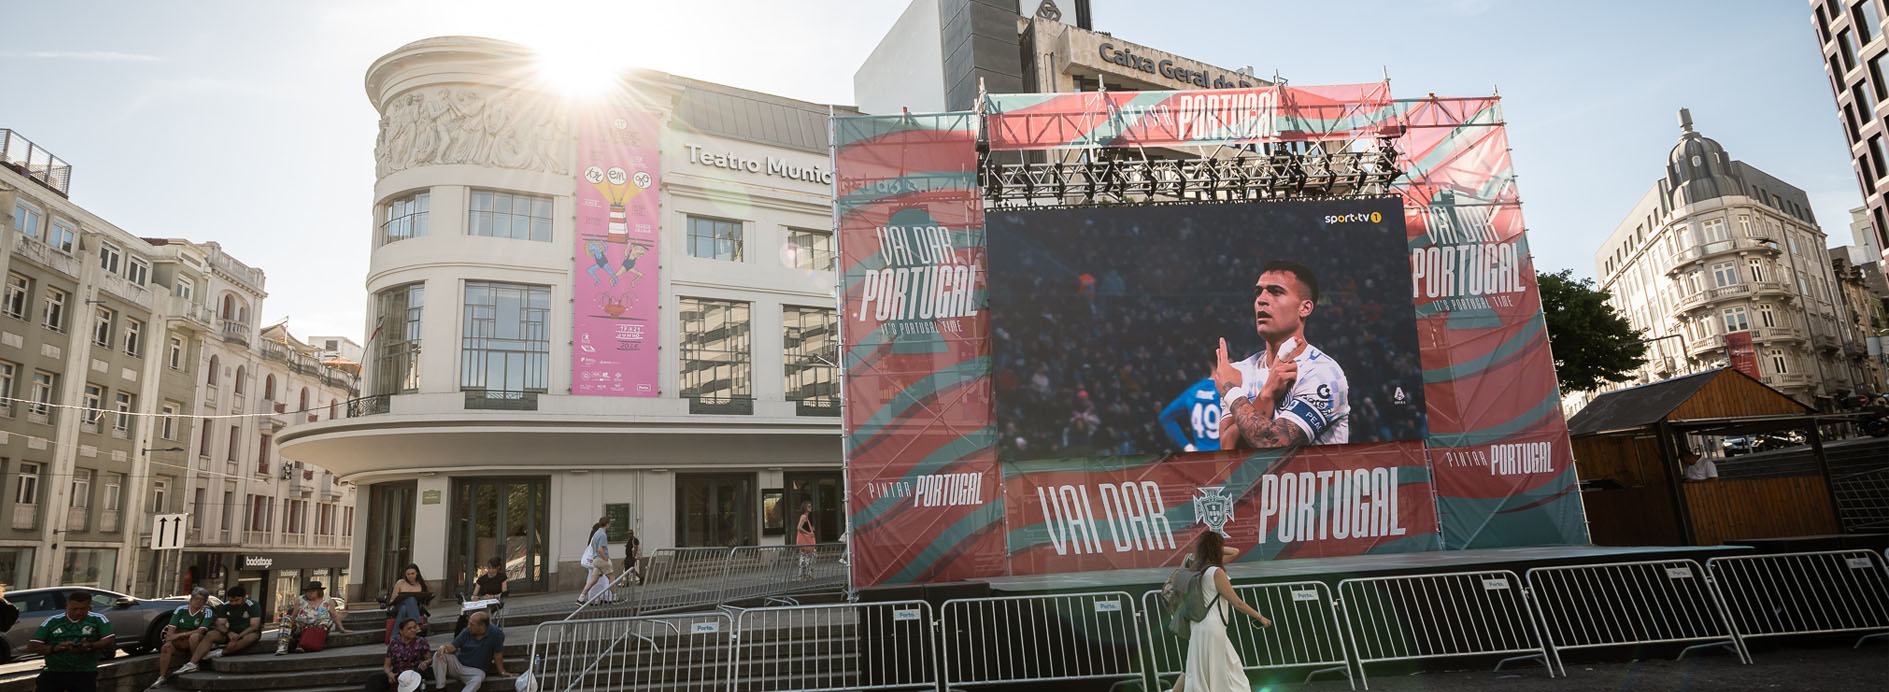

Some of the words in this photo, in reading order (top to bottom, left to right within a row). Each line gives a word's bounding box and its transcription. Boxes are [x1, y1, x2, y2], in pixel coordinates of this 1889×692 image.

[1099, 43, 1156, 74] Caixa
[1159, 59, 1210, 89] Geral
[1178, 91, 1281, 141] PORTUGAL
[685, 143, 760, 173] Teatro
[1421, 207, 1459, 244] VAI
[876, 227, 913, 266] VAI
[912, 226, 958, 265] DAR
[1413, 243, 1526, 298] PORTUGAL
[859, 264, 978, 322] PORTUGAL
[1433, 300, 1450, 311] IT'S
[1451, 297, 1492, 311] PORTUGAL
[1493, 295, 1513, 308] TIME
[881, 323, 897, 336] IT'S
[900, 322, 940, 335] PORTUGAL
[1191, 402, 1220, 439] 49
[1446, 451, 1488, 468] PINTAR
[1490, 441, 1554, 475] PORTUGAL
[867, 481, 912, 499] PINTAR
[914, 472, 983, 507] PORTUGAL
[1038, 484, 1103, 556] VAI
[1099, 481, 1176, 552] DAR
[1258, 467, 1406, 544] PORTUGAL
